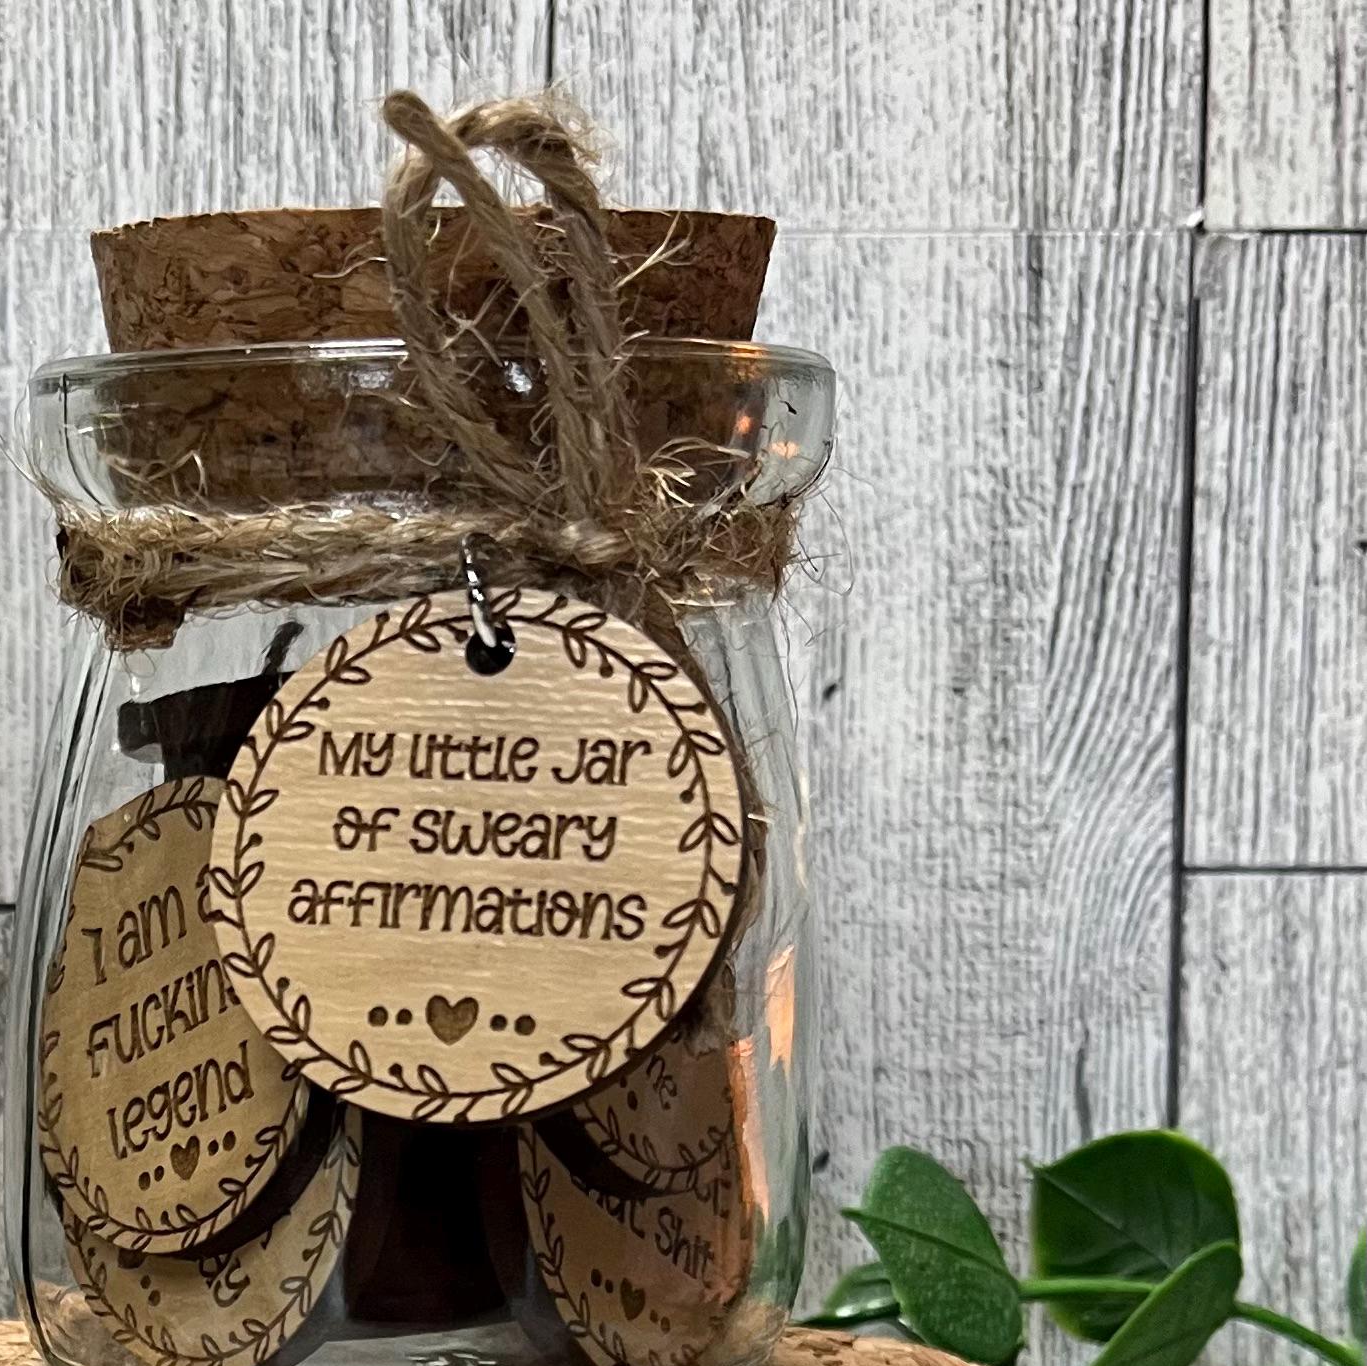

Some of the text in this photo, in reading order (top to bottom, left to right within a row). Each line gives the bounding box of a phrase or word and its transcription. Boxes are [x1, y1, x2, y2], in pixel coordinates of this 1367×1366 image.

[319, 731, 395, 777] My
[333, 806, 618, 861] of sweary
[117, 884, 187, 971] am
[287, 878, 648, 941] affirmations
[86, 958, 240, 1079] fuckin
